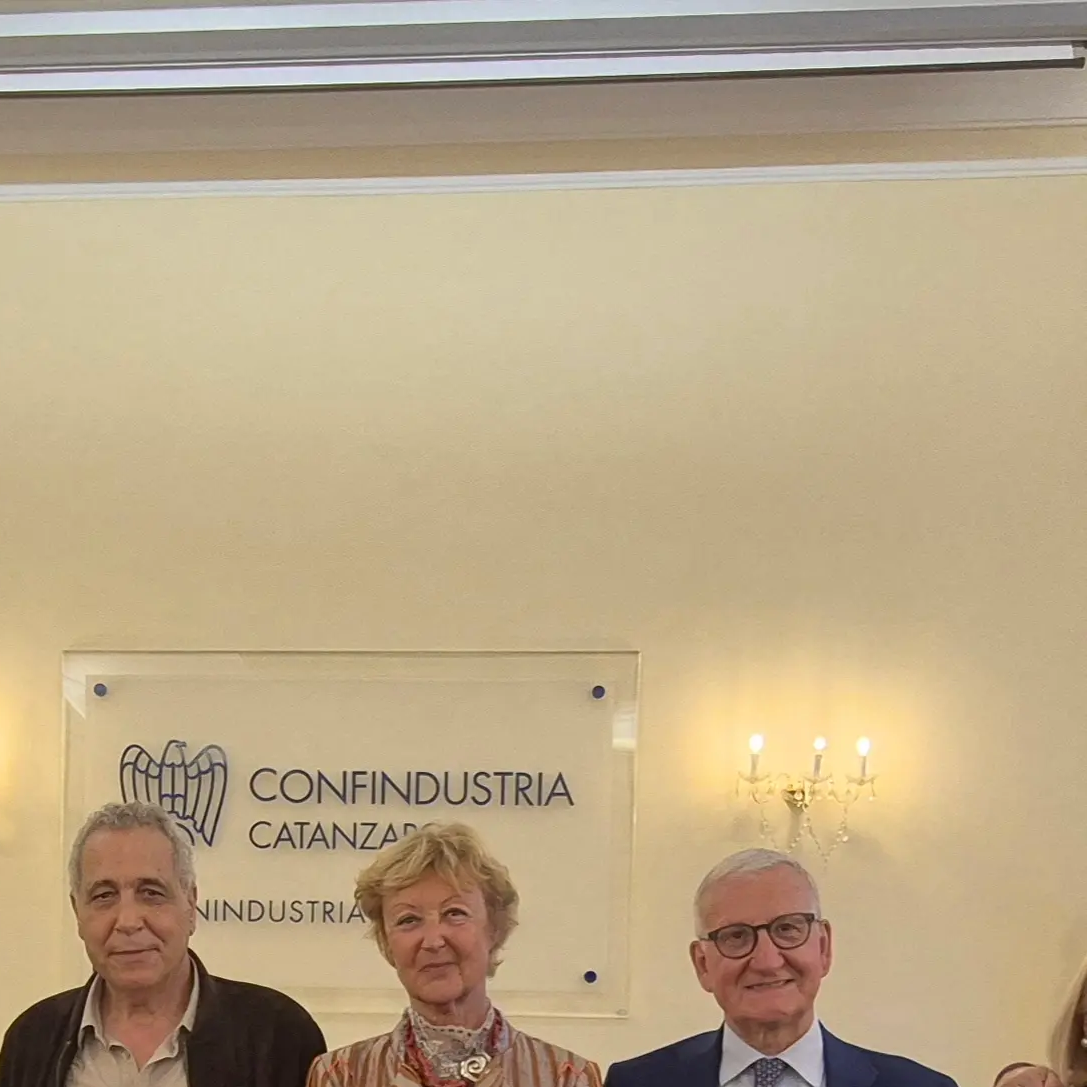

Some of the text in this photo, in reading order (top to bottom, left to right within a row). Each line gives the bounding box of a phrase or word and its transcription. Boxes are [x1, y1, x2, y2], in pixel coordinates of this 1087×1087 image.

[248, 767, 575, 806] CONFINDUSTRIA
[248, 821, 435, 850] CATANZA
[195, 899, 366, 924] NINDUSTRIA
